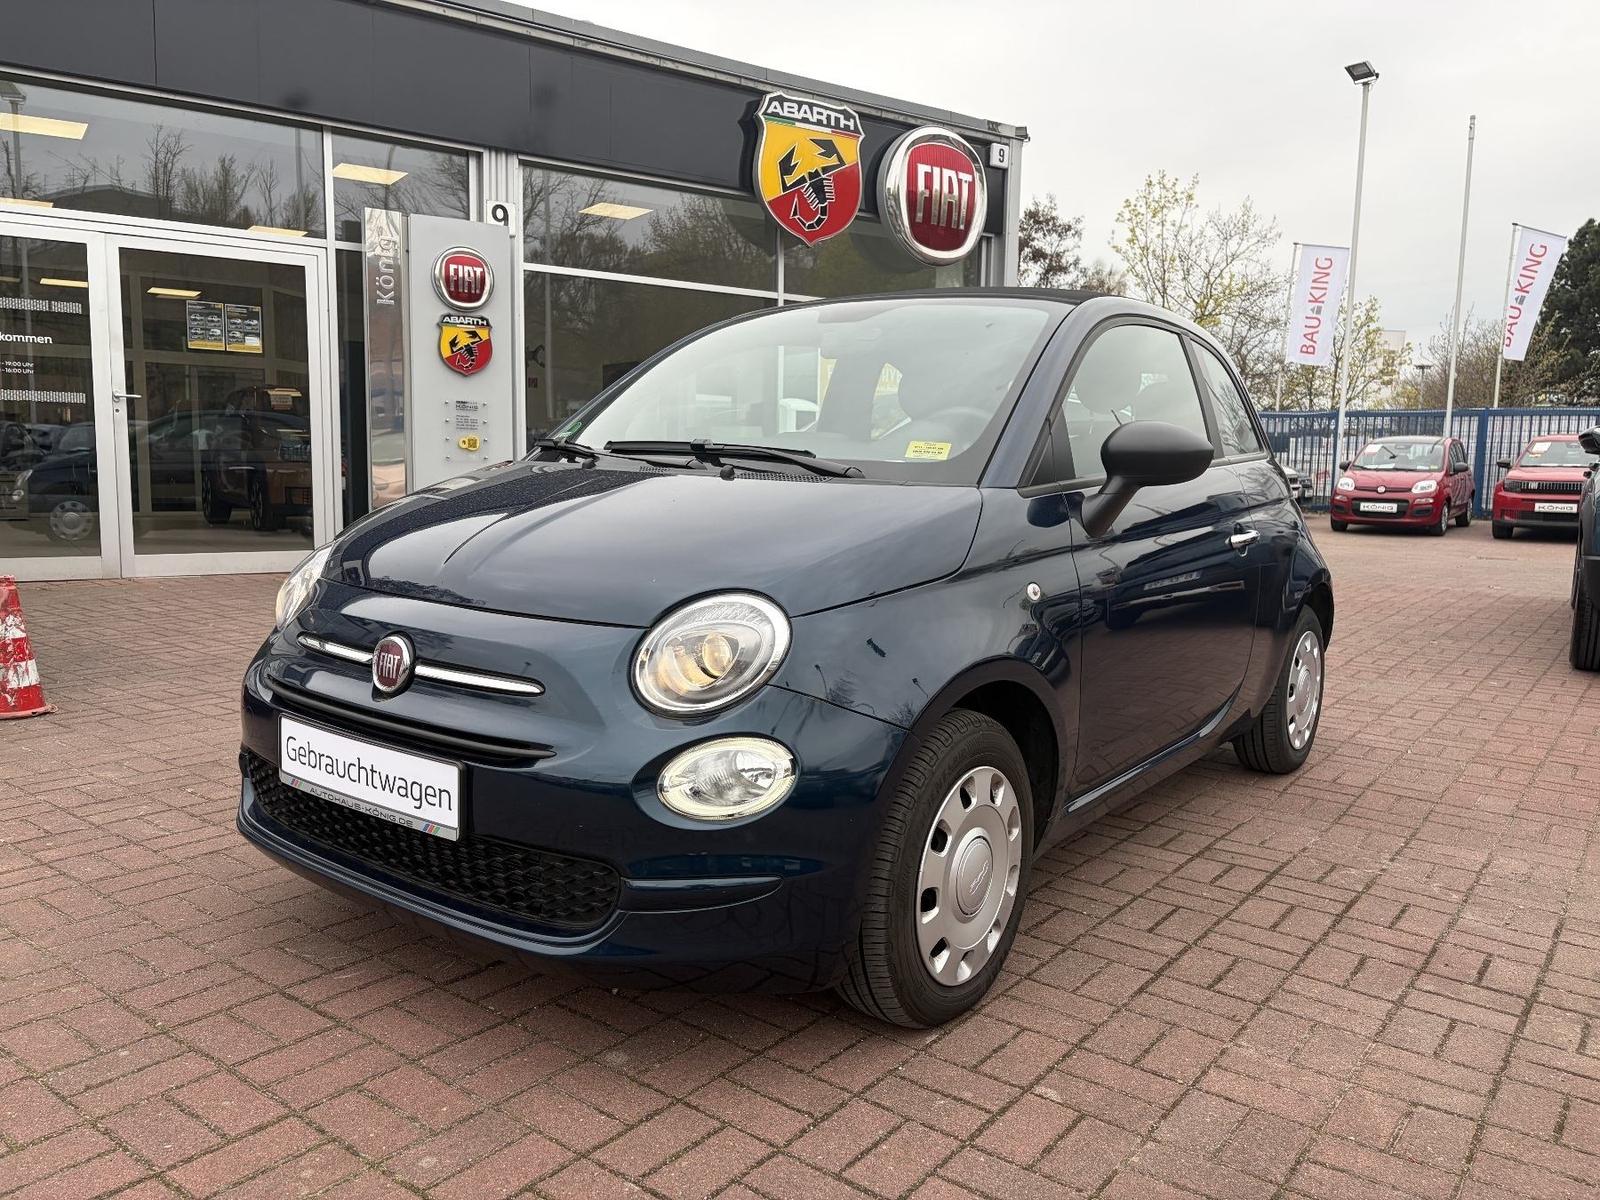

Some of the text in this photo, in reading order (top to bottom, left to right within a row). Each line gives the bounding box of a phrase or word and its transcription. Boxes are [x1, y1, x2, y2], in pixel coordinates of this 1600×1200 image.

[766, 100, 855, 131] ABARTH
[998, 148, 1005, 163] 9
[915, 163, 973, 231] FIAT
[491, 204, 509, 227] 9
[376, 237, 398, 305] König
[449, 263, 484, 294] FIAT
[1514, 243, 1548, 295] KING
[442, 316, 487, 326] ABARTH
[1300, 256, 1333, 356] BAU KING
[378, 652, 400, 679] FIAT
[286, 736, 453, 811] Gebrauchtwagen
[309, 786, 414, 828] AUTOHAUS-KÖNIG.DE
